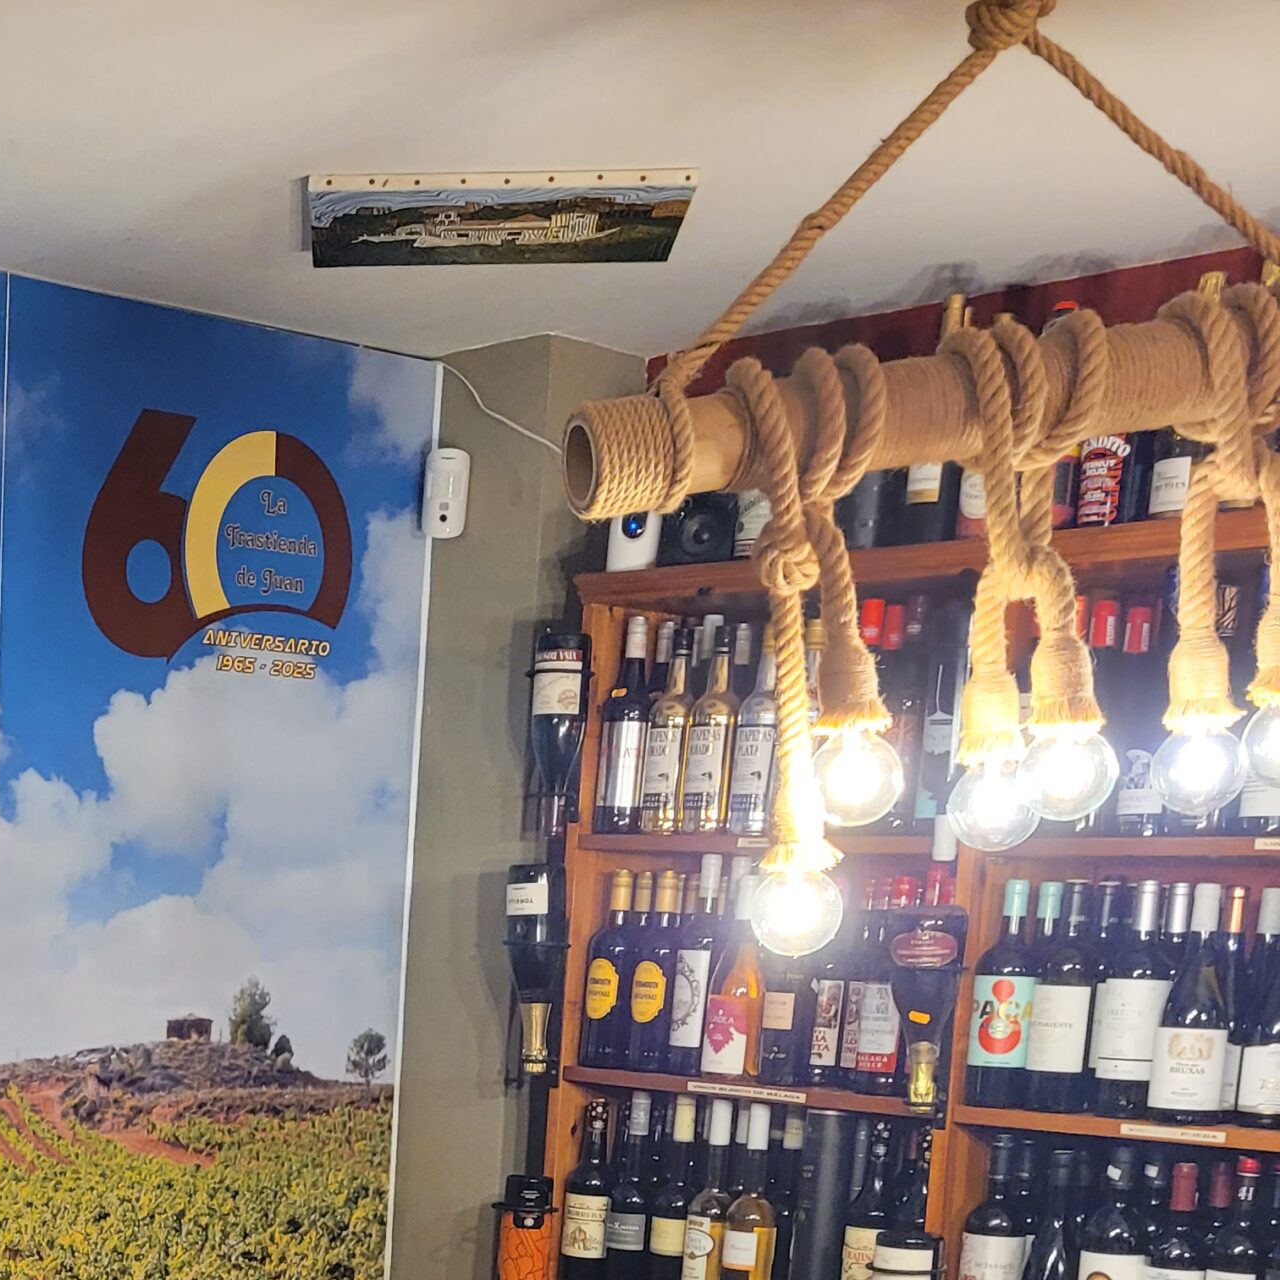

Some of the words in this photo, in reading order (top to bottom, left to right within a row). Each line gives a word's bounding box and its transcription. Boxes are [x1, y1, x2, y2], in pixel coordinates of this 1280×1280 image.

[260, 489, 288, 516] La
[223, 523, 319, 558] Trastienda
[235, 565, 258, 589] de
[262, 567, 305, 596] Juan
[201, 628, 332, 658] ANIVERSARIO
[215, 655, 256, 674] 1965
[270, 661, 317, 681] 2025
